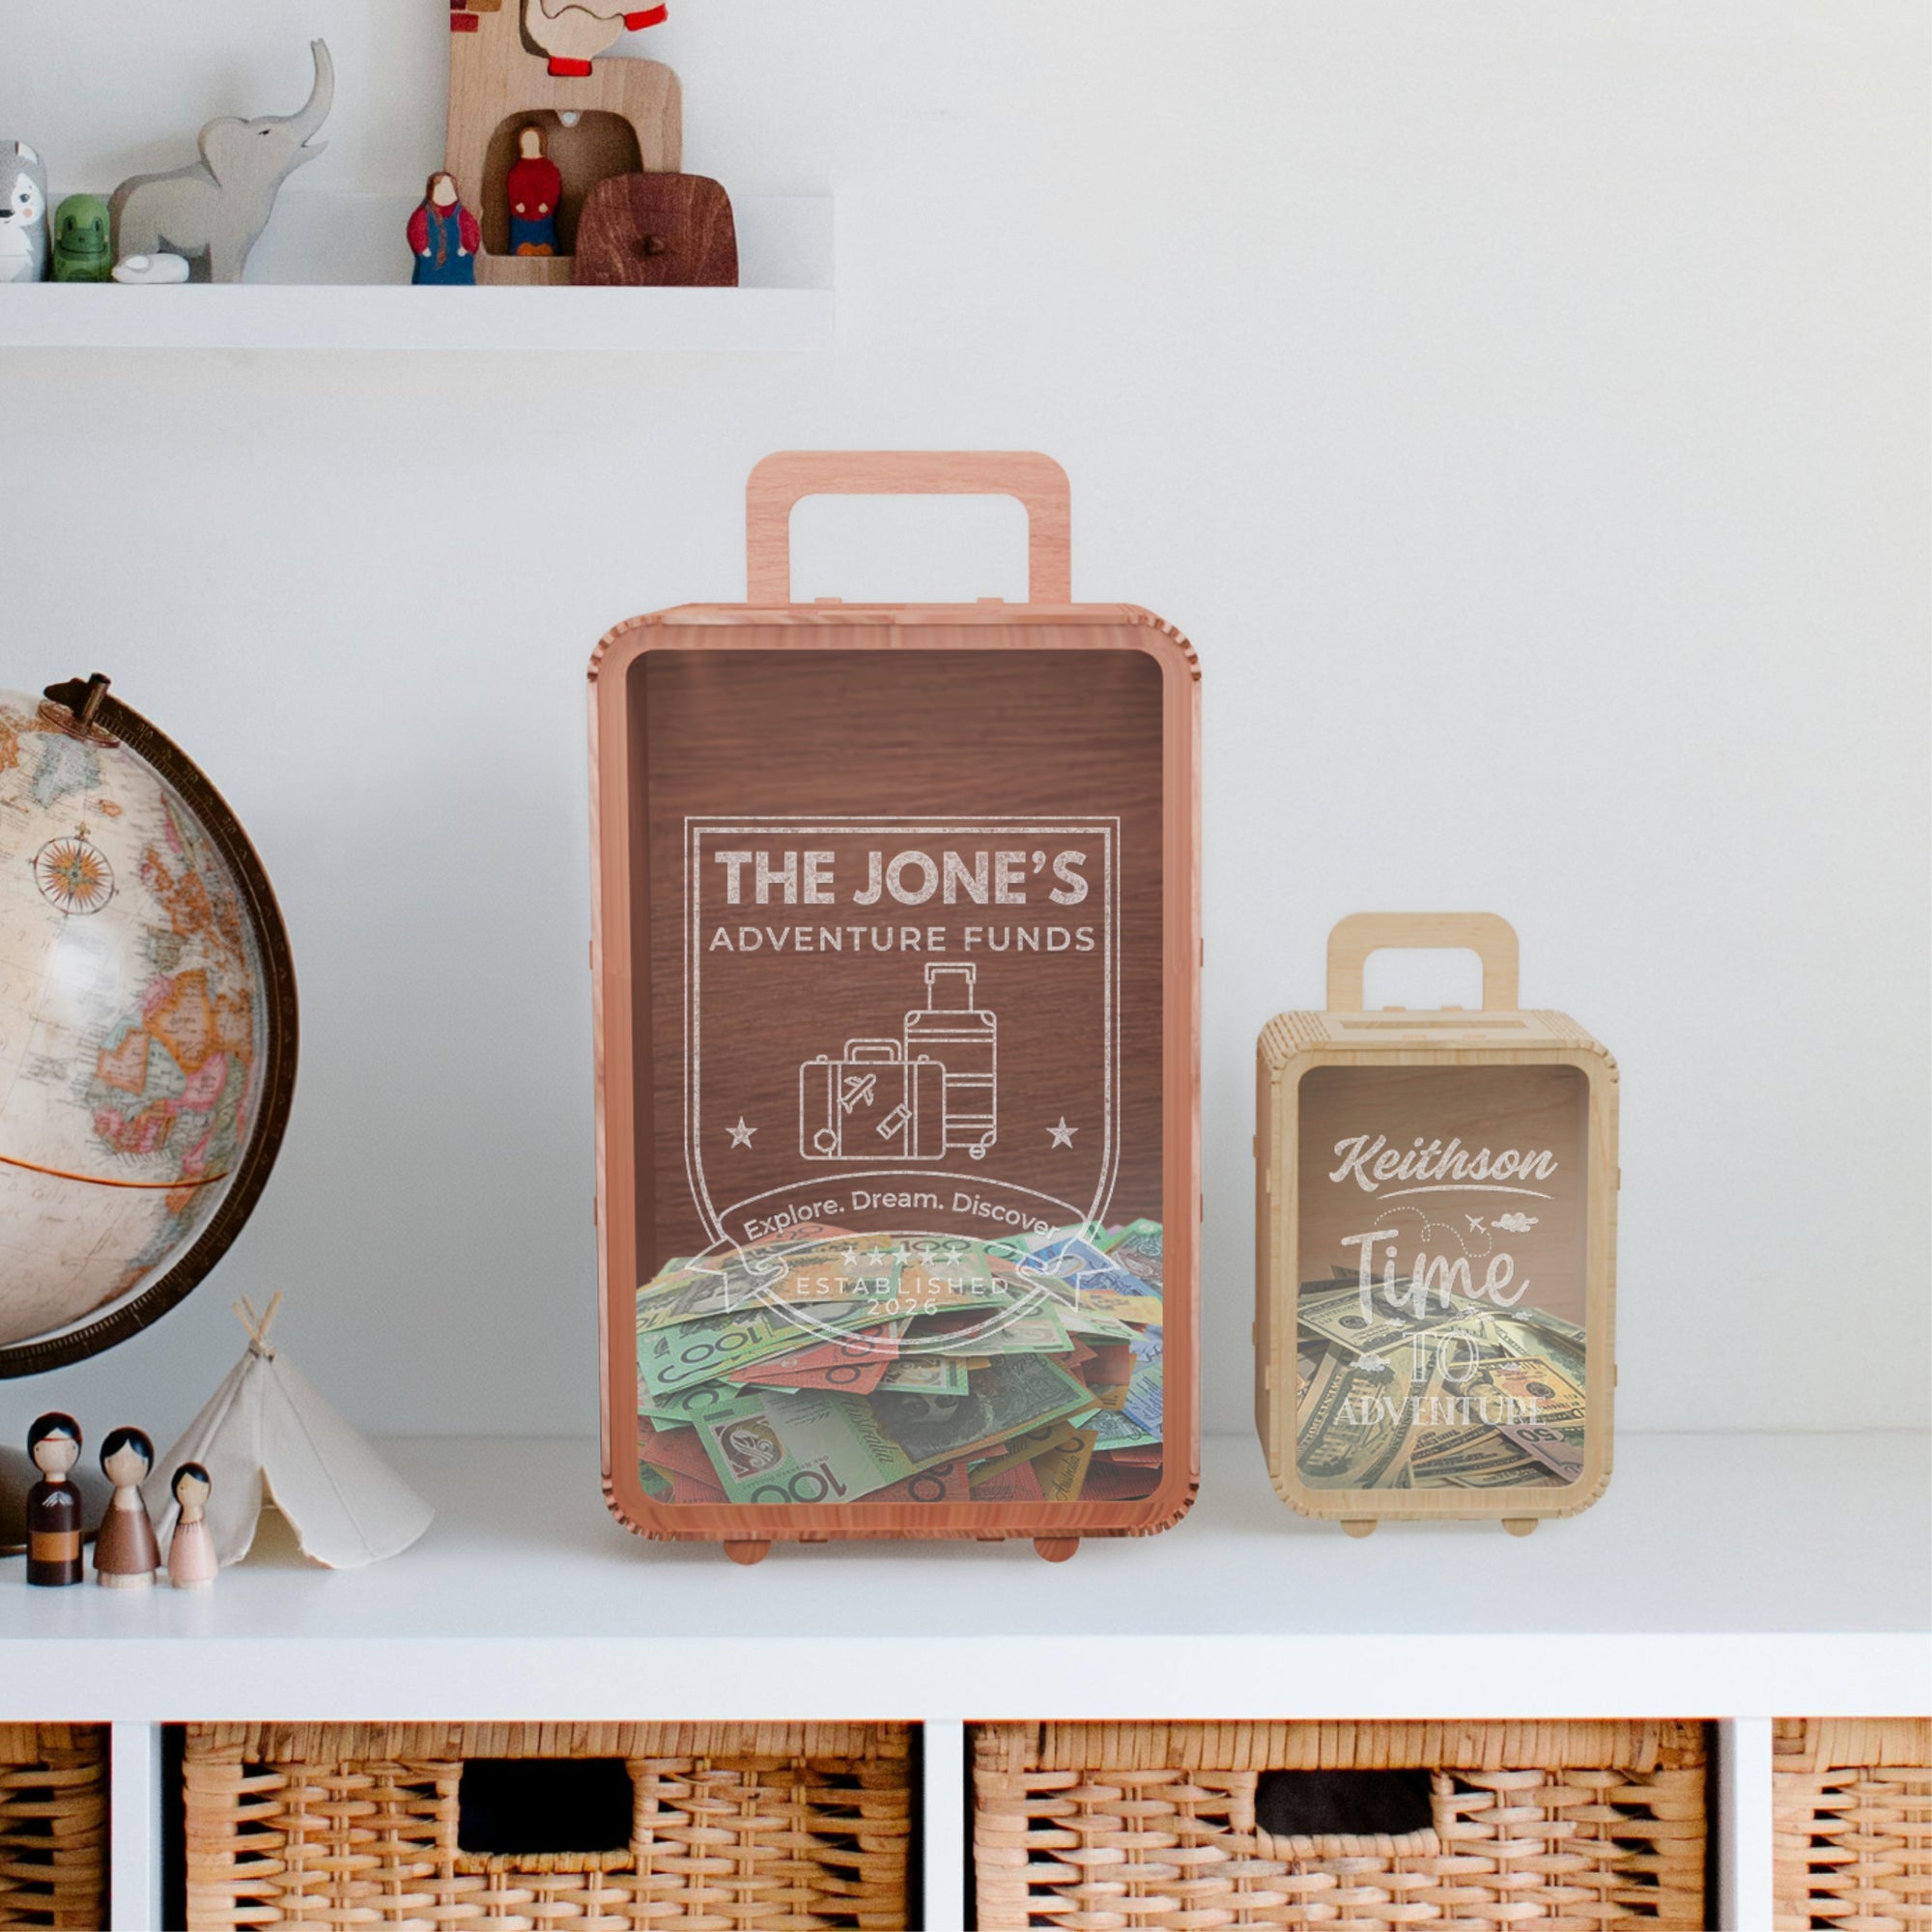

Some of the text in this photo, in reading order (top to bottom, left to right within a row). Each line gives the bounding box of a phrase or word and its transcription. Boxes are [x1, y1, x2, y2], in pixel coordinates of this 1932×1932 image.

[714, 850, 836, 905] THE
[708, 925, 1095, 952] ADVENTURE FUNDS
[1328, 1134, 1559, 1193] Keithson
[743, 1190, 1062, 1241] Explore. Dream. Discover
[796, 1277, 1009, 1295] ESTABLISHED
[1341, 1229, 1530, 1326] Time
[867, 1297, 938, 1316] 2026
[1403, 1331, 1480, 1383] TO
[1333, 1396, 1547, 1426] ADVENTURE
[1516, 1428, 1559, 1442] 50
